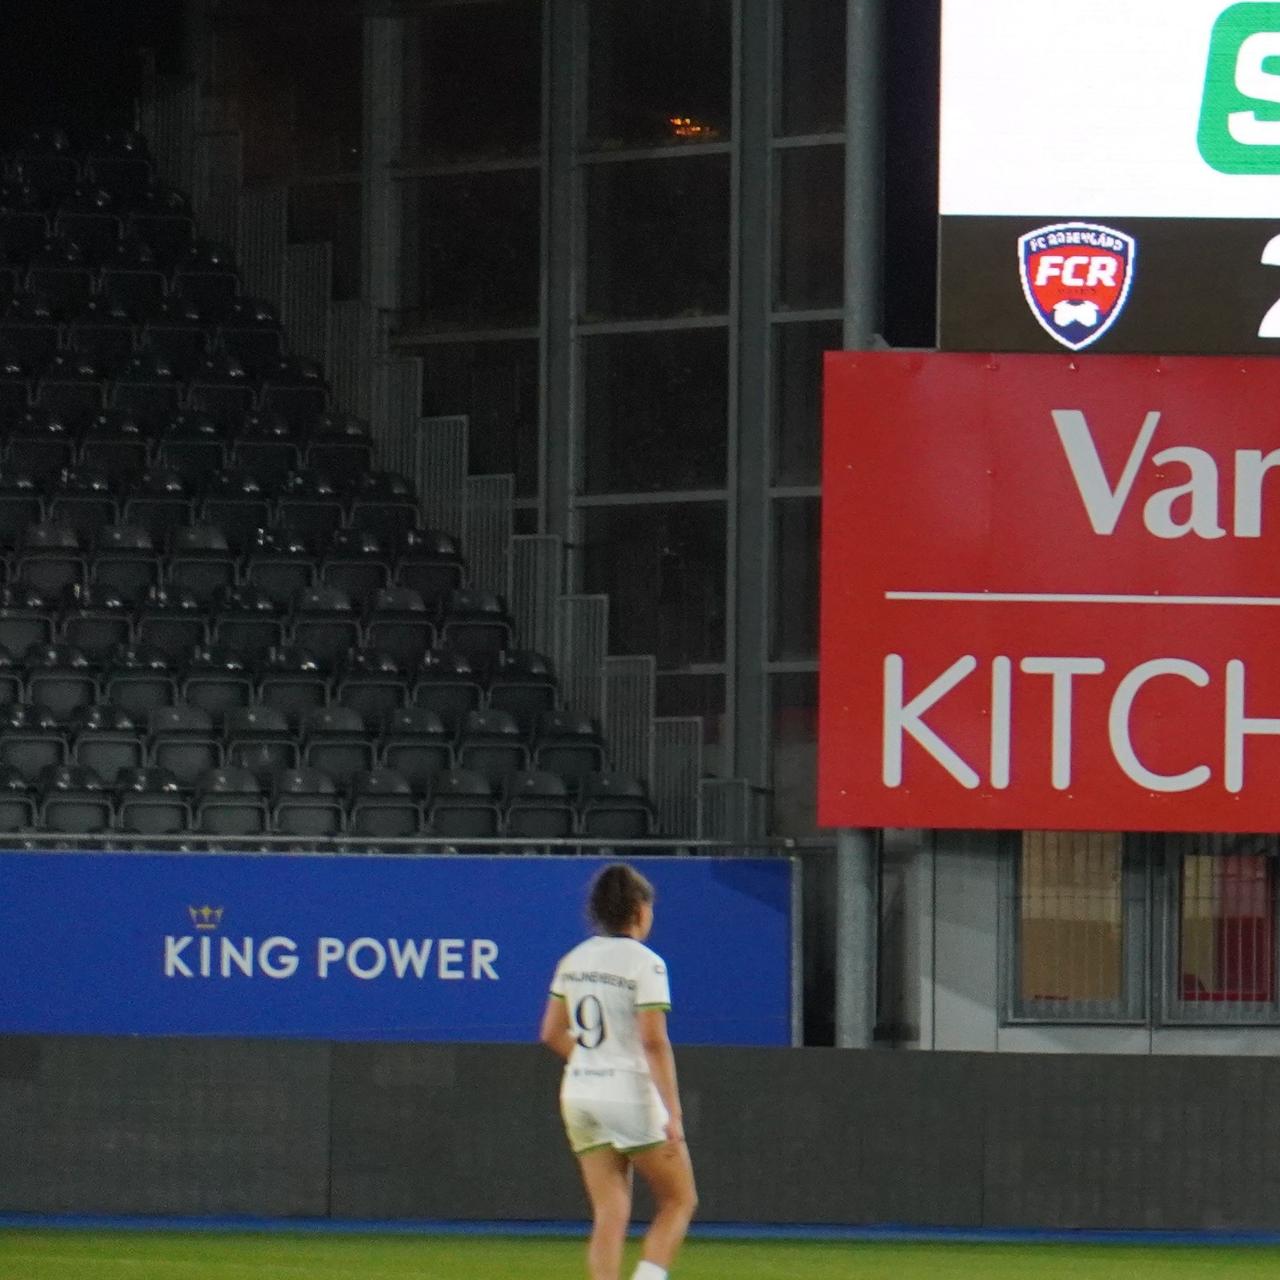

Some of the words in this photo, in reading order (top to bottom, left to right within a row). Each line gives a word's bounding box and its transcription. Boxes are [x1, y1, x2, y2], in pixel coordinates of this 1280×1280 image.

[1034, 255, 1118, 287] FCR
[163, 934, 299, 980] KING
[317, 936, 500, 981] POWER
[576, 994, 606, 1049] 9
